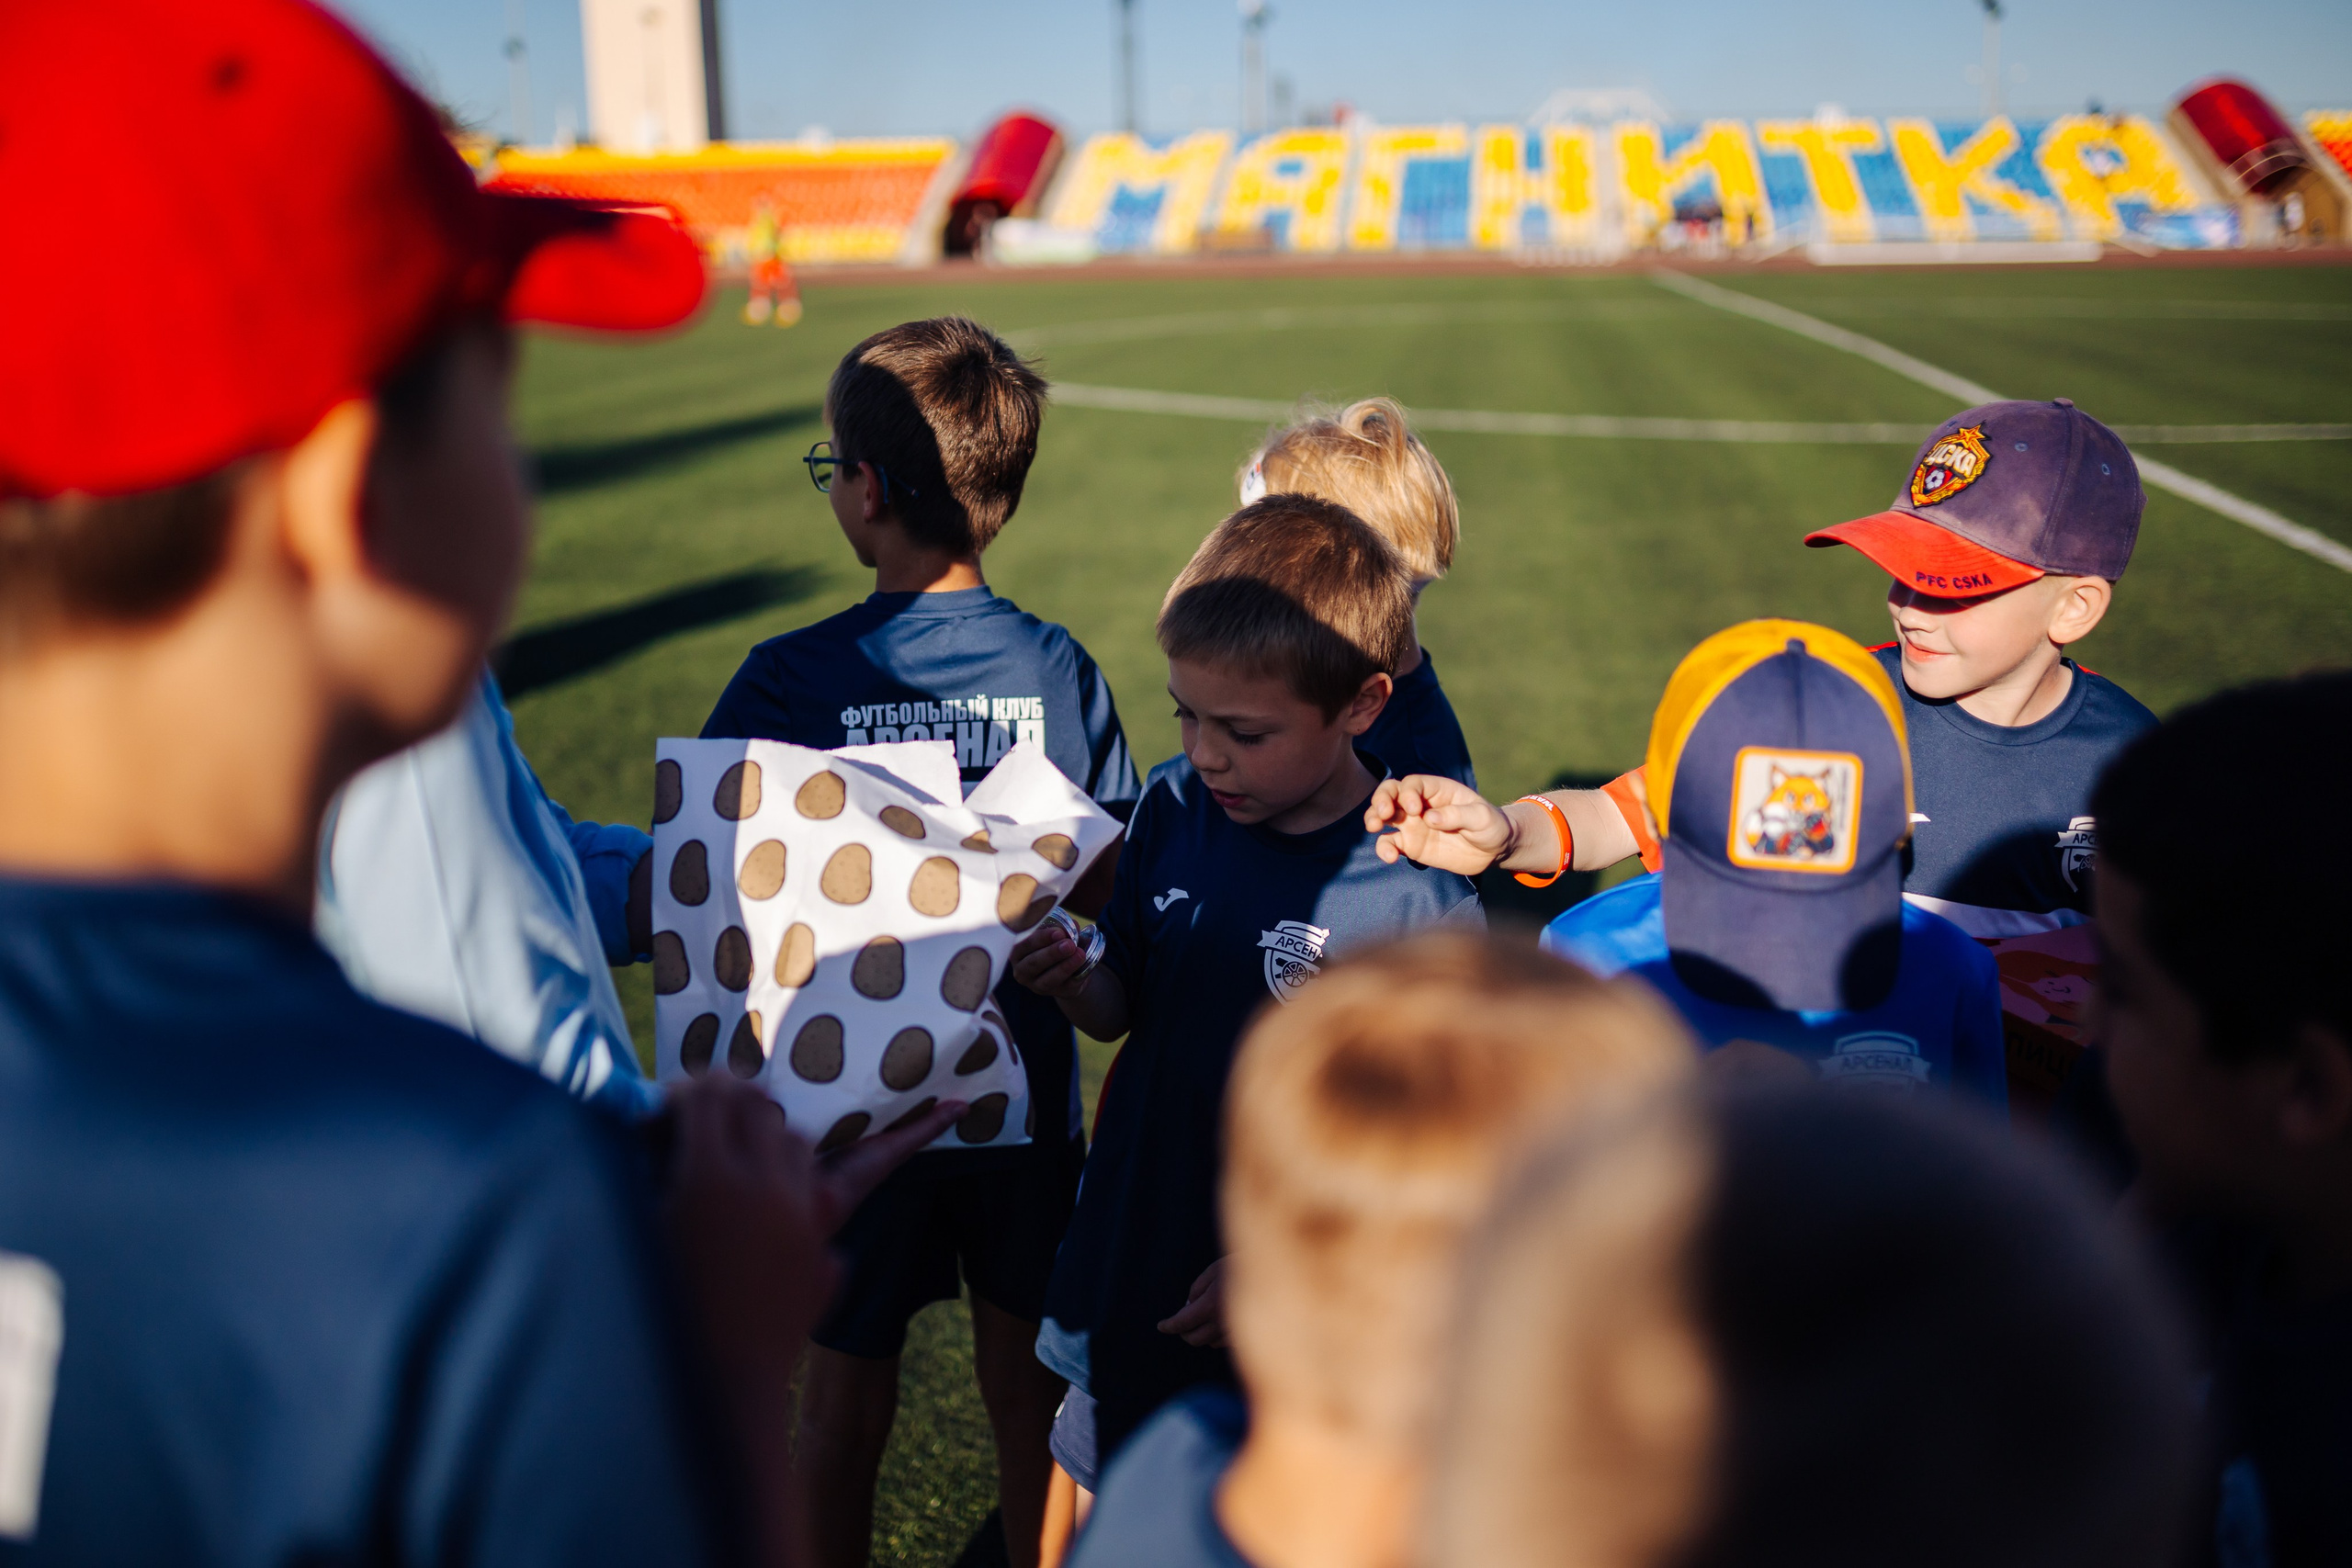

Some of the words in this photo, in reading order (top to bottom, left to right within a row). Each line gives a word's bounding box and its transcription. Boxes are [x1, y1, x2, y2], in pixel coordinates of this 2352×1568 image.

[1050, 113, 2200, 254] МАГНИТКА
[1916, 571, 1948, 589] PFC
[1952, 573, 1993, 590] CSKA
[840, 694, 989, 728] ФУТБОЛЬНЫЙ
[991, 696, 1045, 721] КЛУБ
